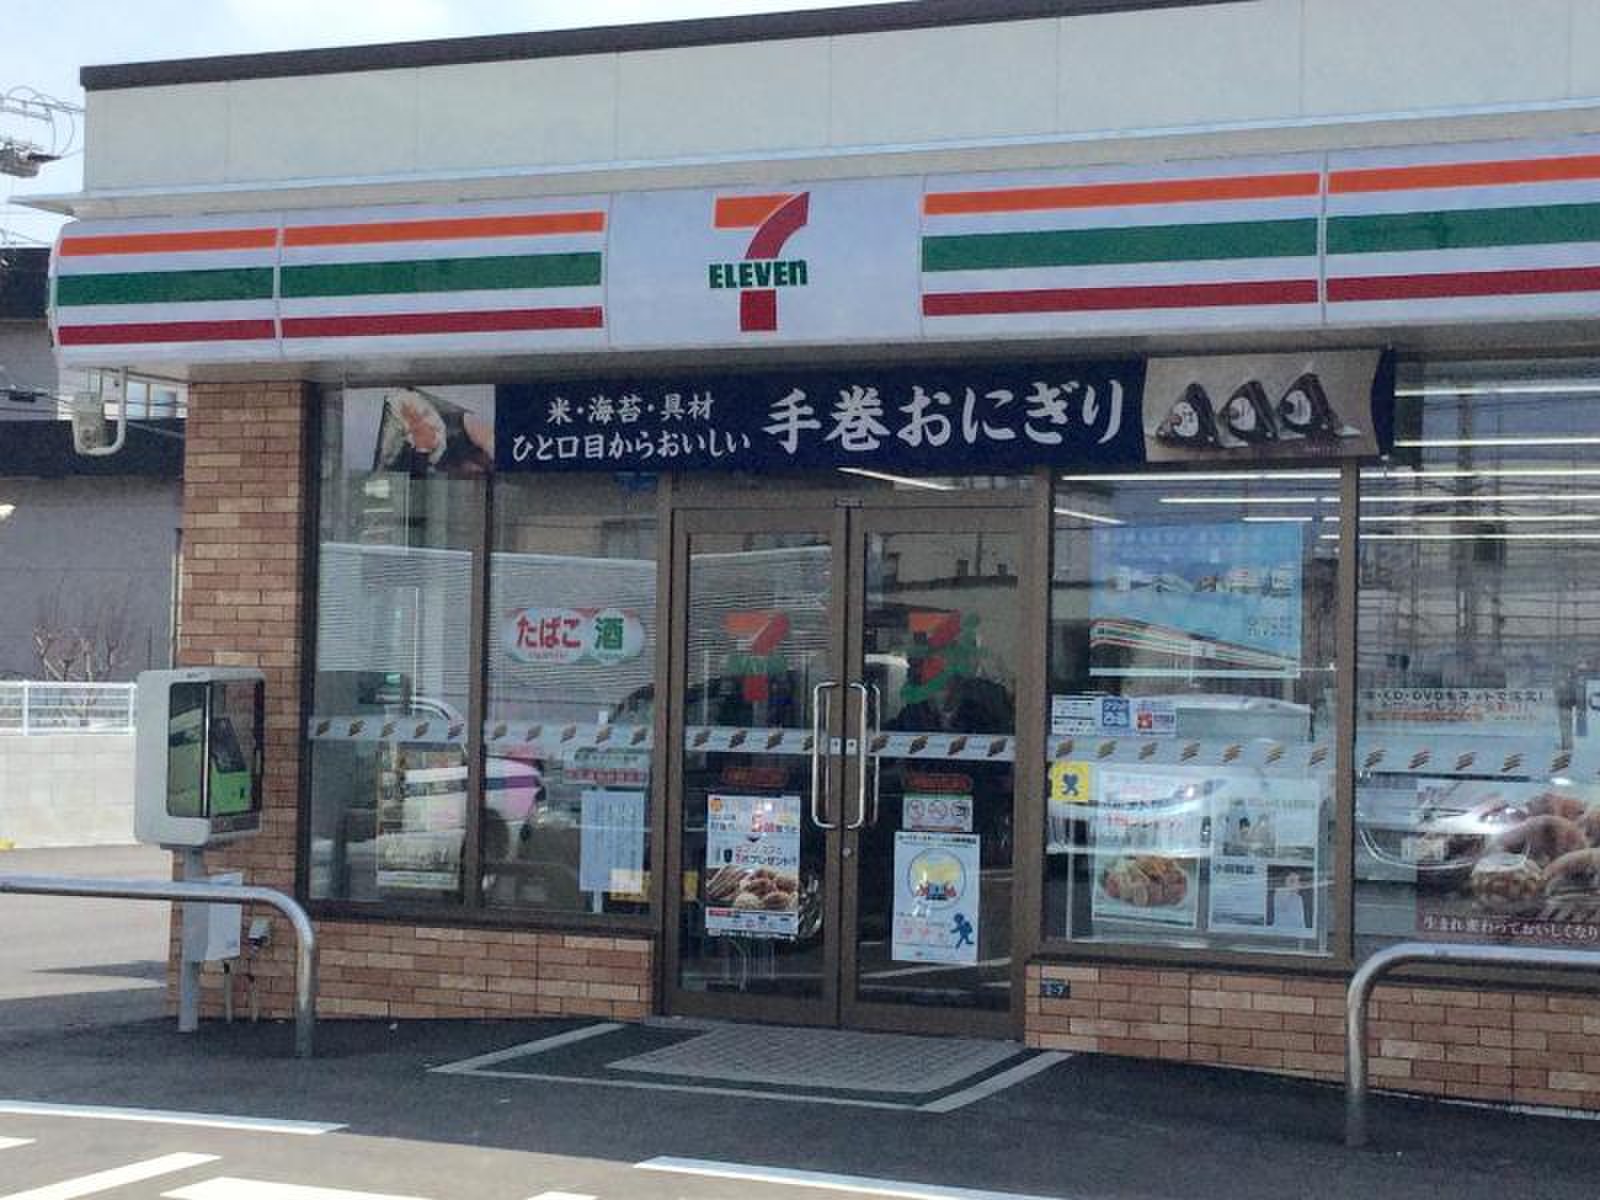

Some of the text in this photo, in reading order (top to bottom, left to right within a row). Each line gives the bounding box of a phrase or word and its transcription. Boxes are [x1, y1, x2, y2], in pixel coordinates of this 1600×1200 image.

[713, 191, 809, 332] 7
[547, 393, 713, 425] 米・海苔・具材
[763, 380, 1124, 453] 手巻おにぎり
[512, 428, 751, 463] ひと口目からおいしい
[516, 616, 624, 650] たばこ 酒
